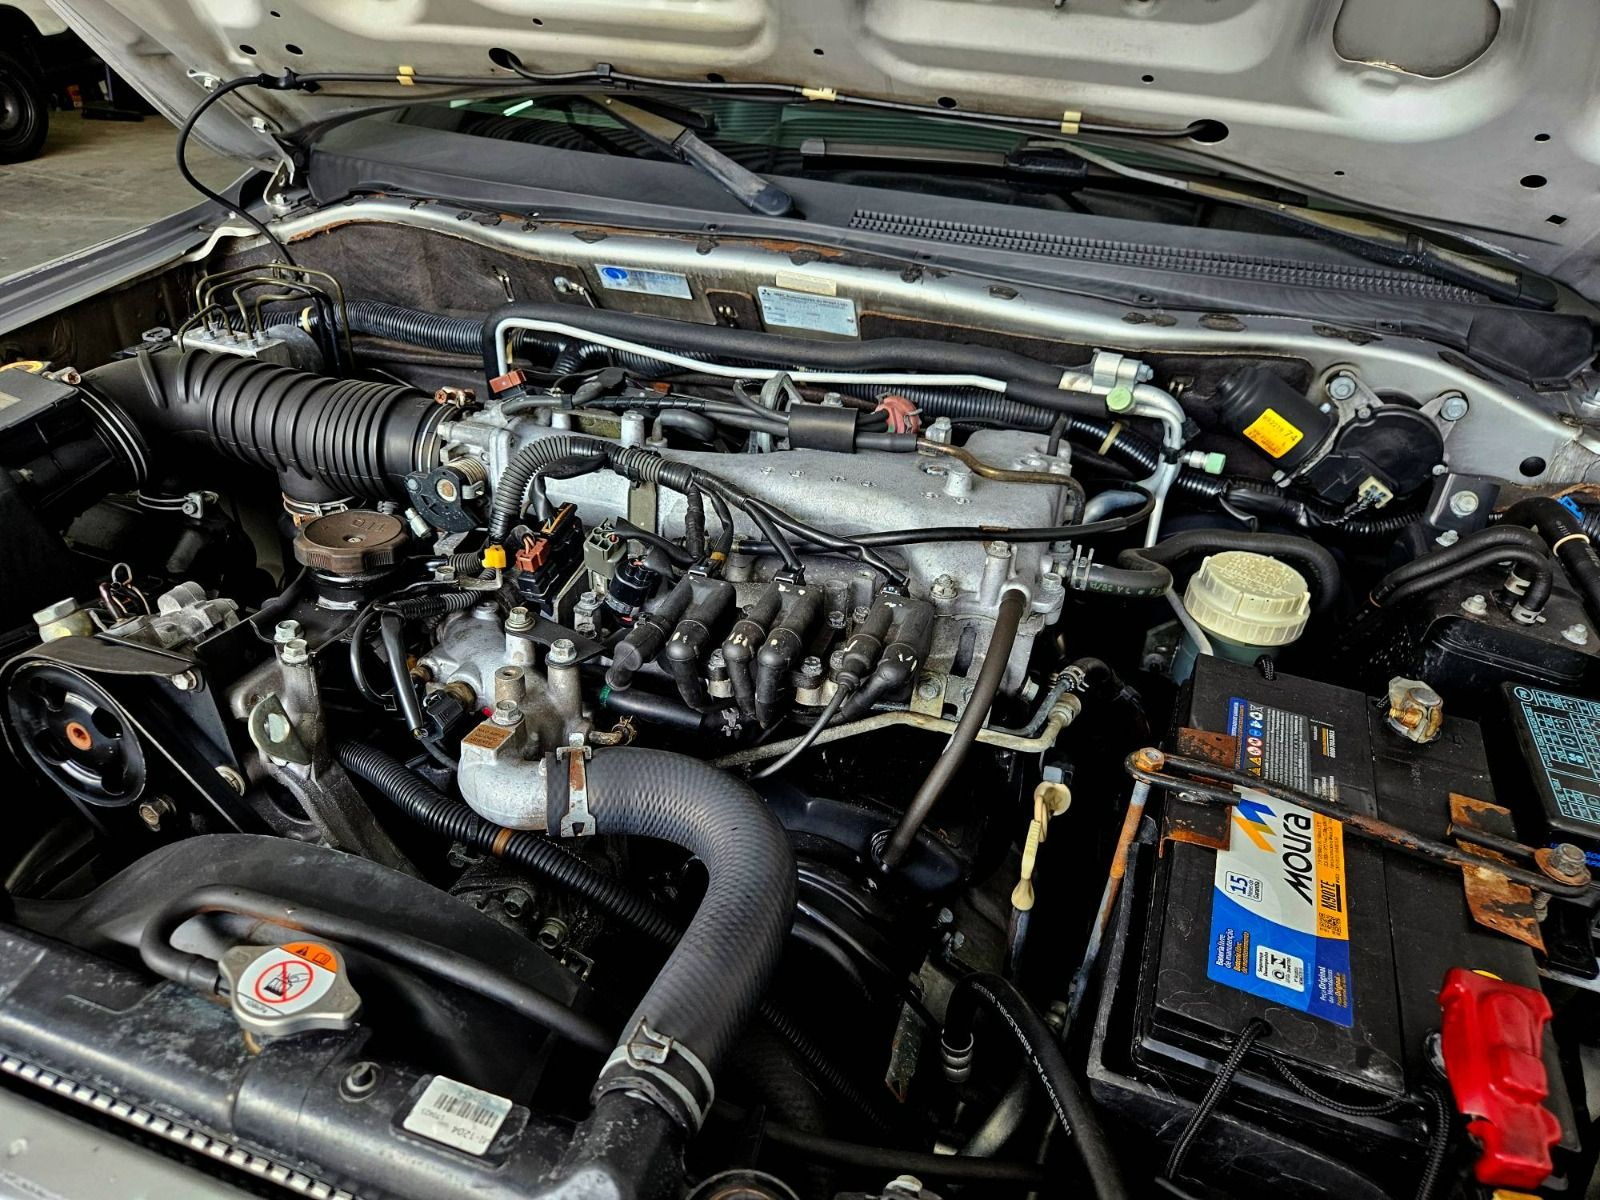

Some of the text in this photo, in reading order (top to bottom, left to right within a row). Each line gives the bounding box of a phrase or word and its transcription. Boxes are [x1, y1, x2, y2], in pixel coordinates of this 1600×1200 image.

[1230, 876, 1248, 895] 15
[1320, 880, 1336, 910] M90TE
[1216, 946, 1226, 966] Bateria
[1318, 966, 1328, 990] Original
